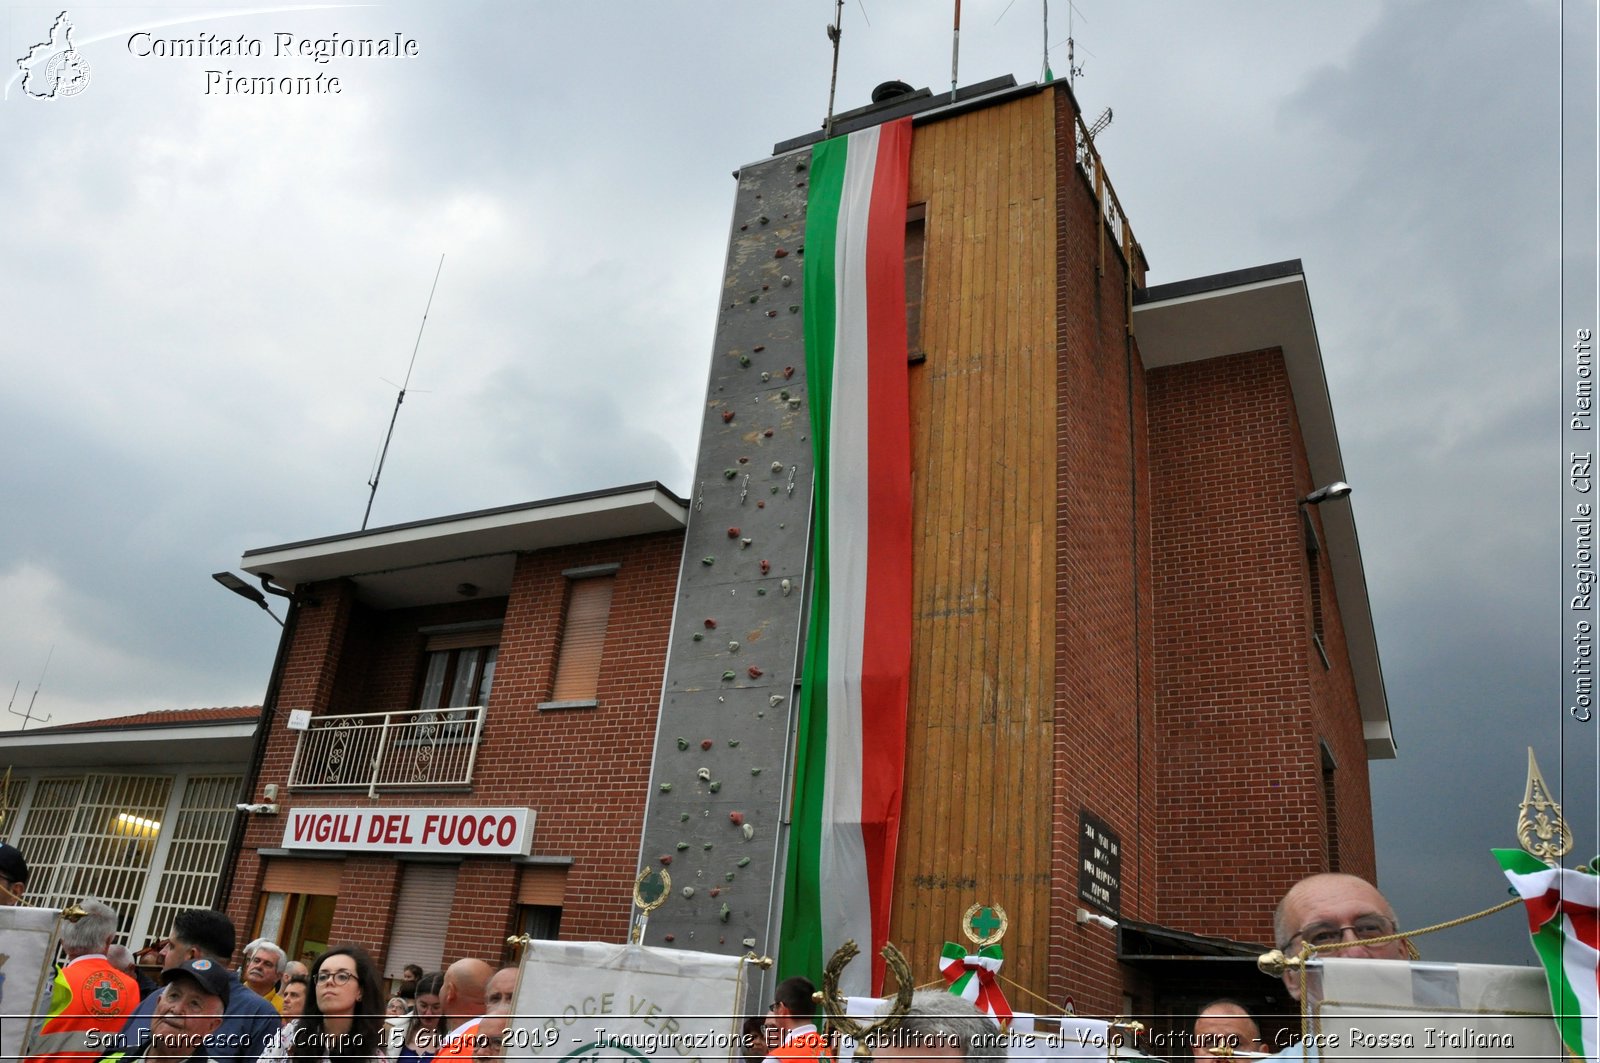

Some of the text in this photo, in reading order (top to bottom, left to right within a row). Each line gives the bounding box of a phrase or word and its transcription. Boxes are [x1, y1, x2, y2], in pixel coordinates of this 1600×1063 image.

[294, 814, 518, 847] VIGILI DEL FUOCO
